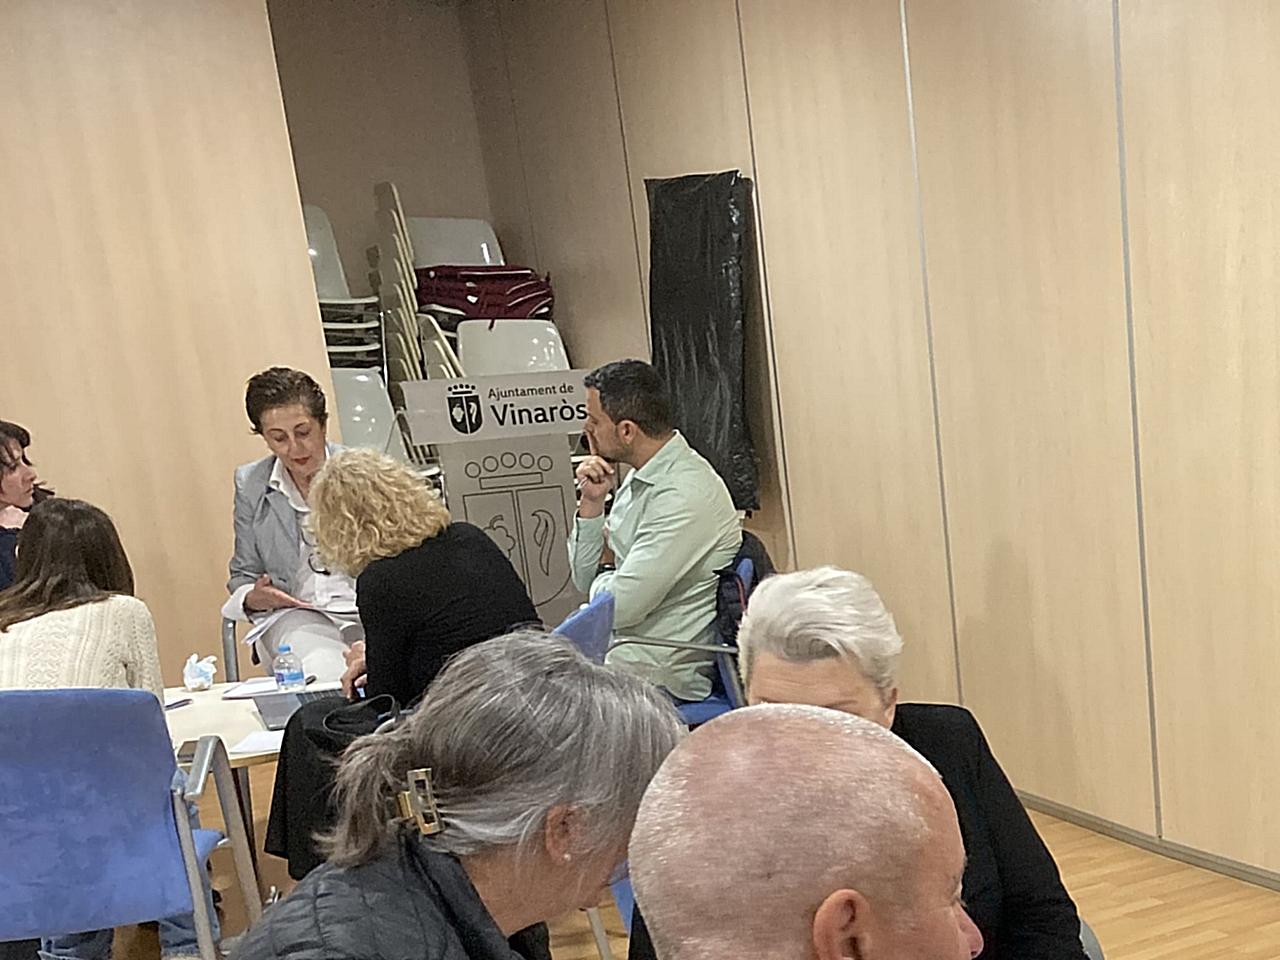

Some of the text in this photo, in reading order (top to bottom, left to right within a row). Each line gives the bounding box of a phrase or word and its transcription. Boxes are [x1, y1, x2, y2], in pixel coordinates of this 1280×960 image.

[488, 382, 574, 401] Ajuntament de
[490, 399, 588, 426] Vinaròs
